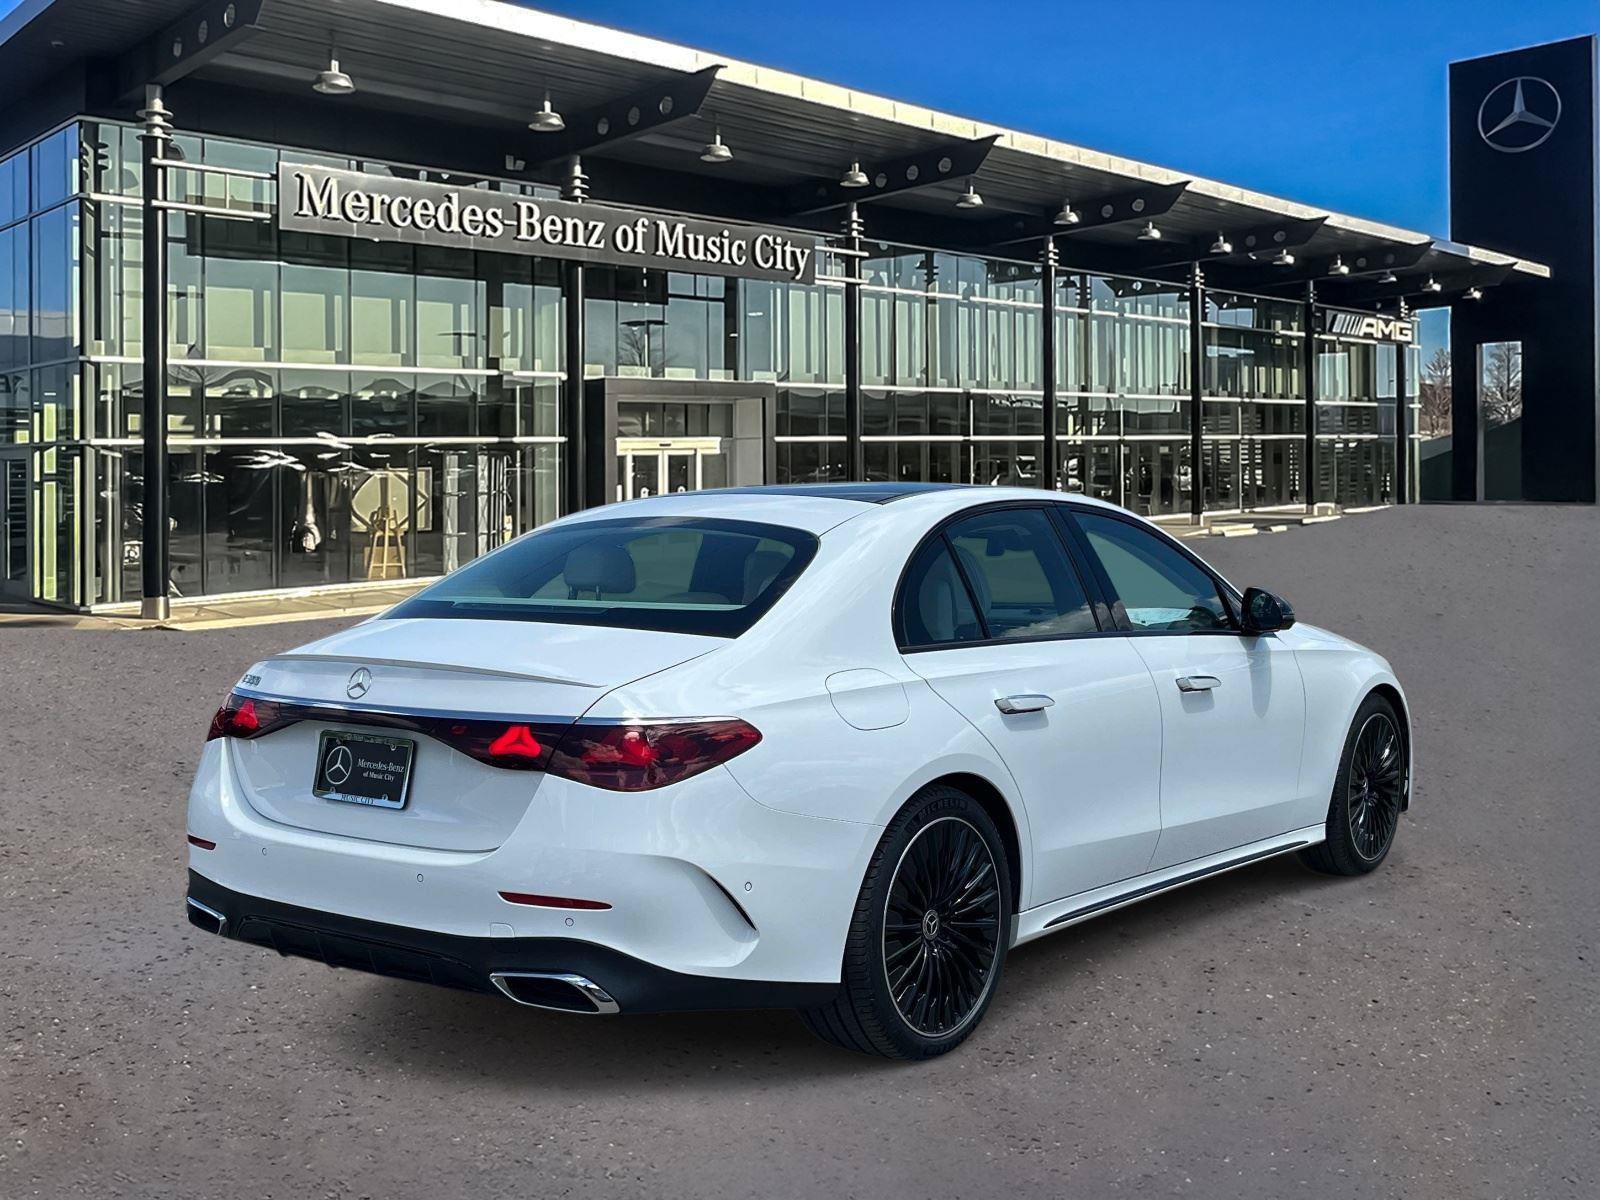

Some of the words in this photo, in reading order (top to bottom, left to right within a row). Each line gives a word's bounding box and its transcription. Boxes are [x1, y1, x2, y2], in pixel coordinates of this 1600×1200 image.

[294, 171, 606, 249] Mercedes-Benz
[614, 217, 649, 254] of
[655, 219, 747, 266] Music
[753, 234, 811, 280] City
[1360, 317, 1413, 342] AMG
[357, 758, 404, 773] Mercedes-Benz
[362, 770, 369, 778] of
[369, 771, 383, 780] Music
[384, 773, 395, 782] City
